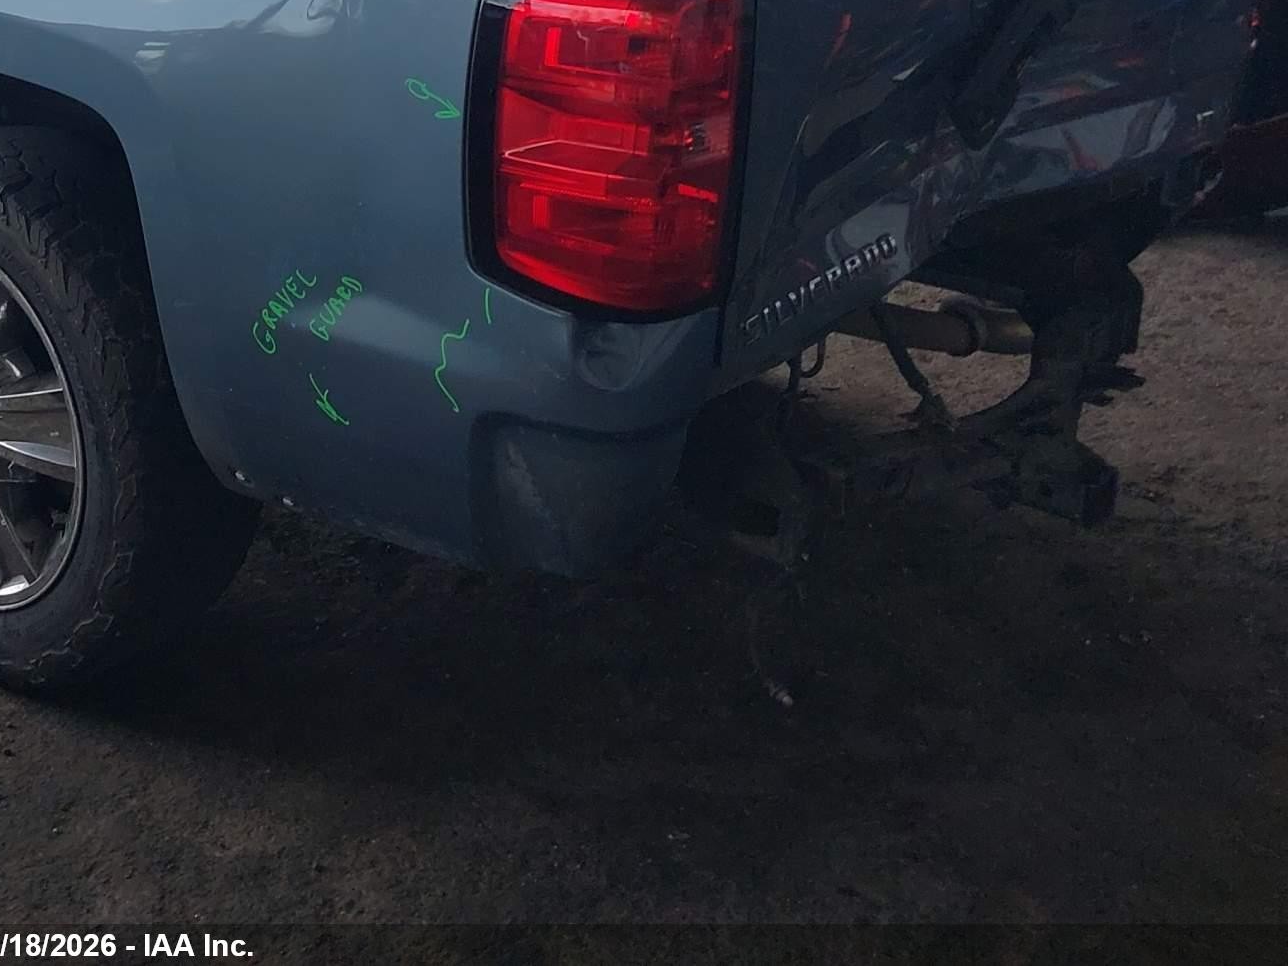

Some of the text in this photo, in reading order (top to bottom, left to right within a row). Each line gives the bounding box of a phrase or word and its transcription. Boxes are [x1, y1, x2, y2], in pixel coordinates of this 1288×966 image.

[253, 268, 317, 354] GRAVEL
[309, 276, 363, 341] GUARD
[744, 234, 898, 346] SILVERADO
